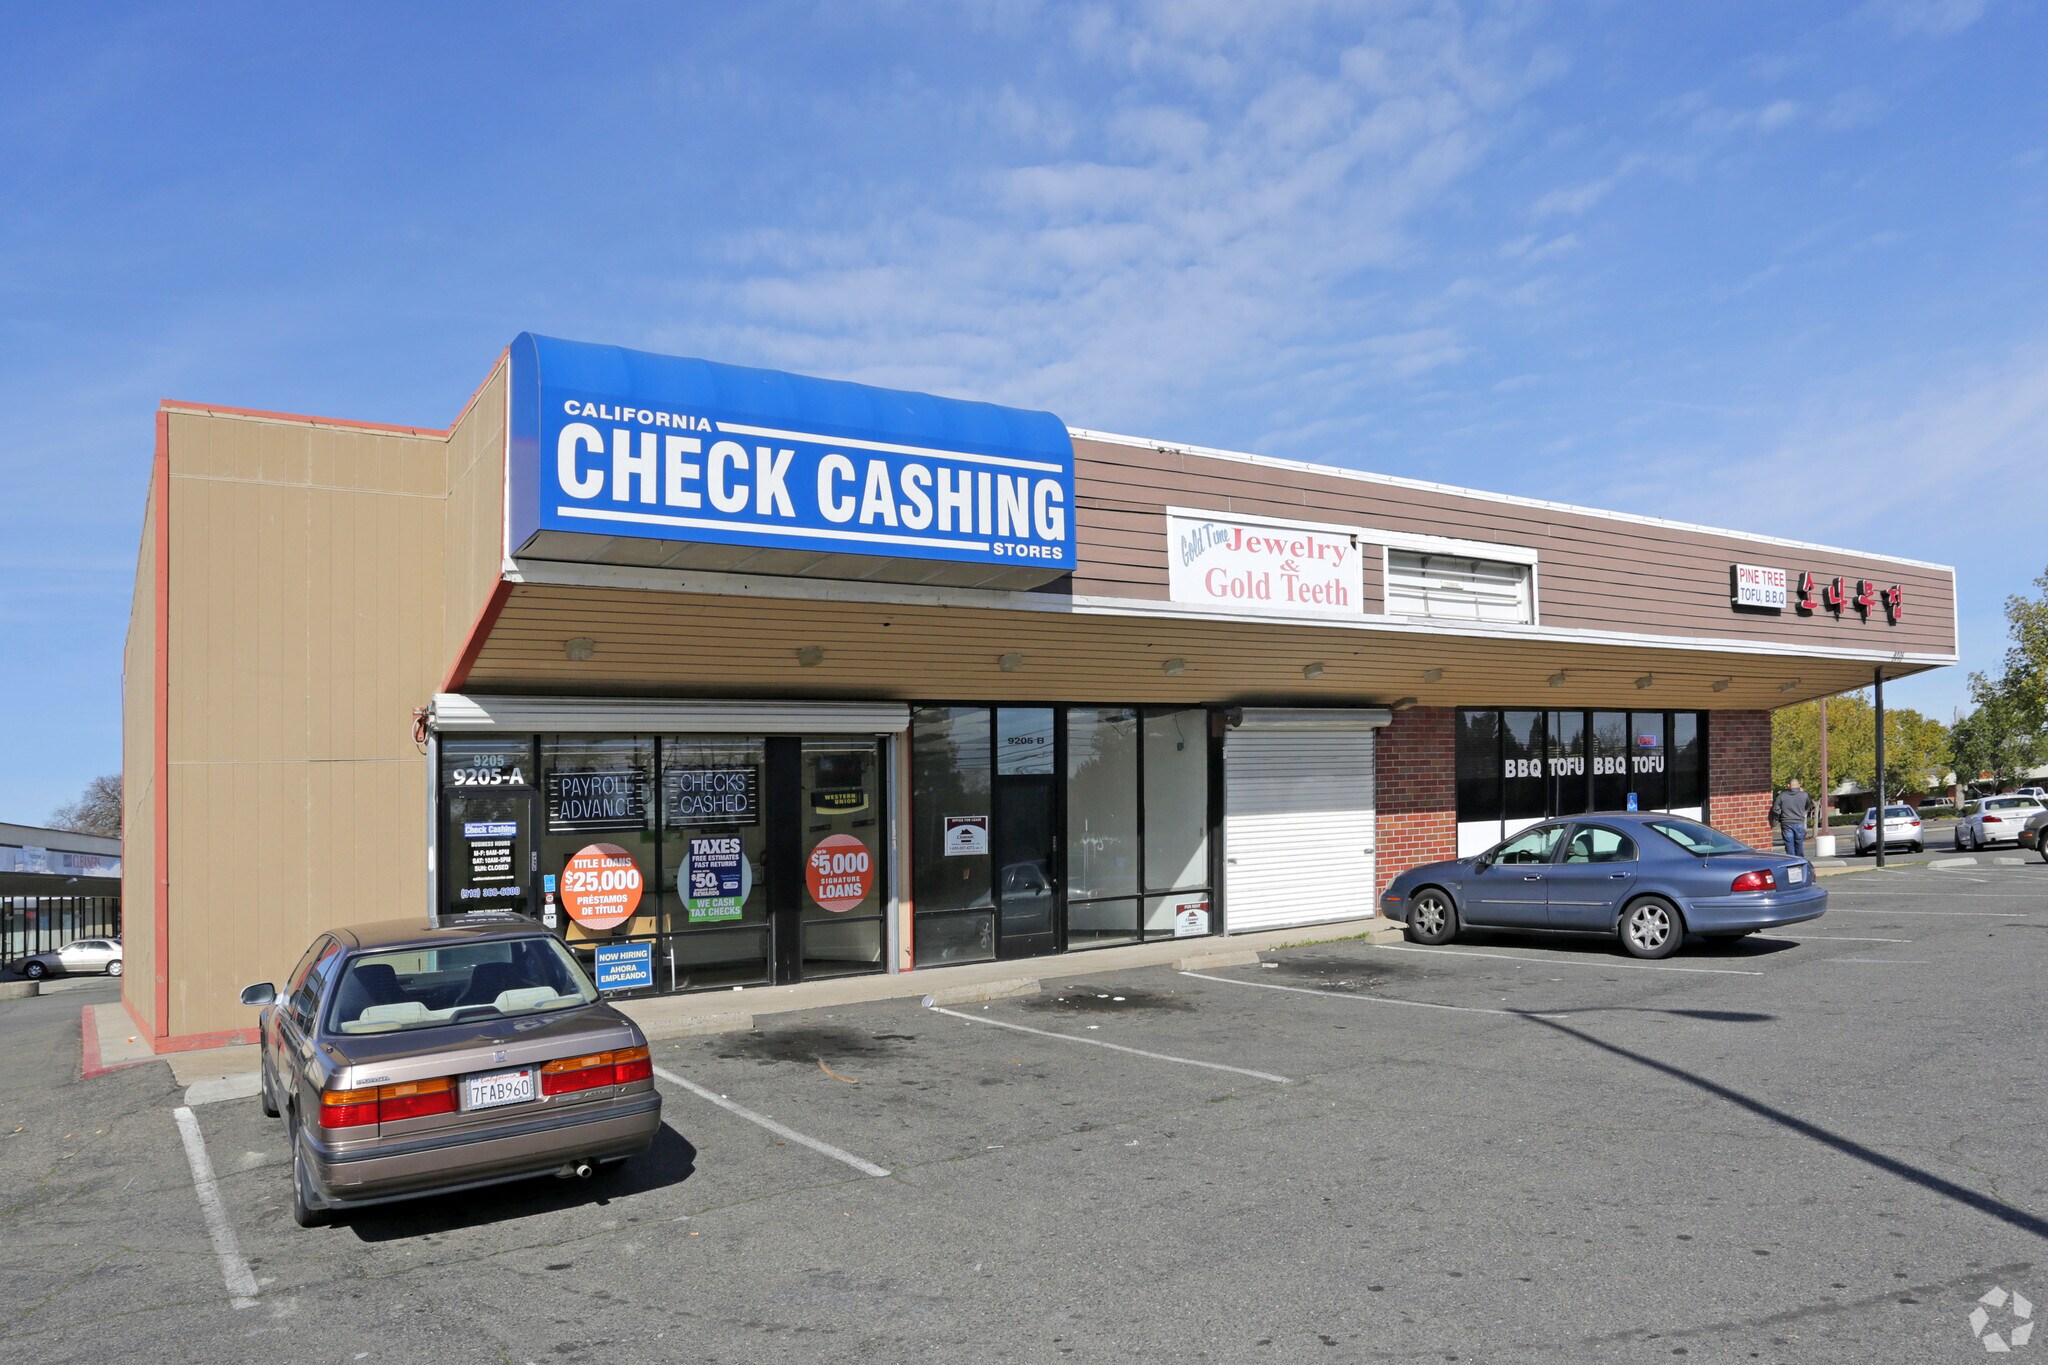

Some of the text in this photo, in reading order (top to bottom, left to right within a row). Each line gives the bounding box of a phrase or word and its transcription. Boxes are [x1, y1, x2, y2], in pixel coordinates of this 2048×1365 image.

[564, 399, 713, 432] CALIFORNIA
[557, 422, 1065, 541] CHECK CASHING
[993, 542, 1063, 560] STORES
[1181, 523, 1230, 567] Gold Time
[1226, 527, 1348, 568] Jewelry
[1280, 559, 1301, 573] &
[1205, 567, 1348, 606] Gold Teeth
[1740, 568, 1785, 587] PINE TREE
[1801, 571, 1902, 619] 소나무집
[474, 755, 504, 767] 9205
[1504, 755, 1665, 778] BBQ TOFU BBQ TOFU
[453, 767, 524, 786] 9205-A
[680, 774, 745, 793] CHECKS
[562, 776, 633, 797] PAYROLL
[560, 797, 635, 819] ADVANCE
[680, 793, 748, 814] CASHED
[464, 825, 487, 834] Check
[488, 824, 517, 834] Cashing
[691, 838, 740, 855] TAXES
[573, 857, 632, 868] TITLE LOANS
[811, 852, 869, 876] $5,000
[565, 869, 640, 892] $25,000
[820, 875, 860, 884] SIGNATURE
[577, 894, 628, 905] PRÉSTAMOS
[818, 883, 862, 899] LOANS
[581, 905, 624, 916] DE TÍTULO
[691, 906, 741, 917] TAX CHECKS
[697, 898, 735, 908] WE CASH
[599, 950, 647, 961] NOW HIRING
[601, 971, 647, 983] EMPLEANDO
[610, 964, 637, 973] AHORA
[472, 1080, 529, 1104] 7FAB960
